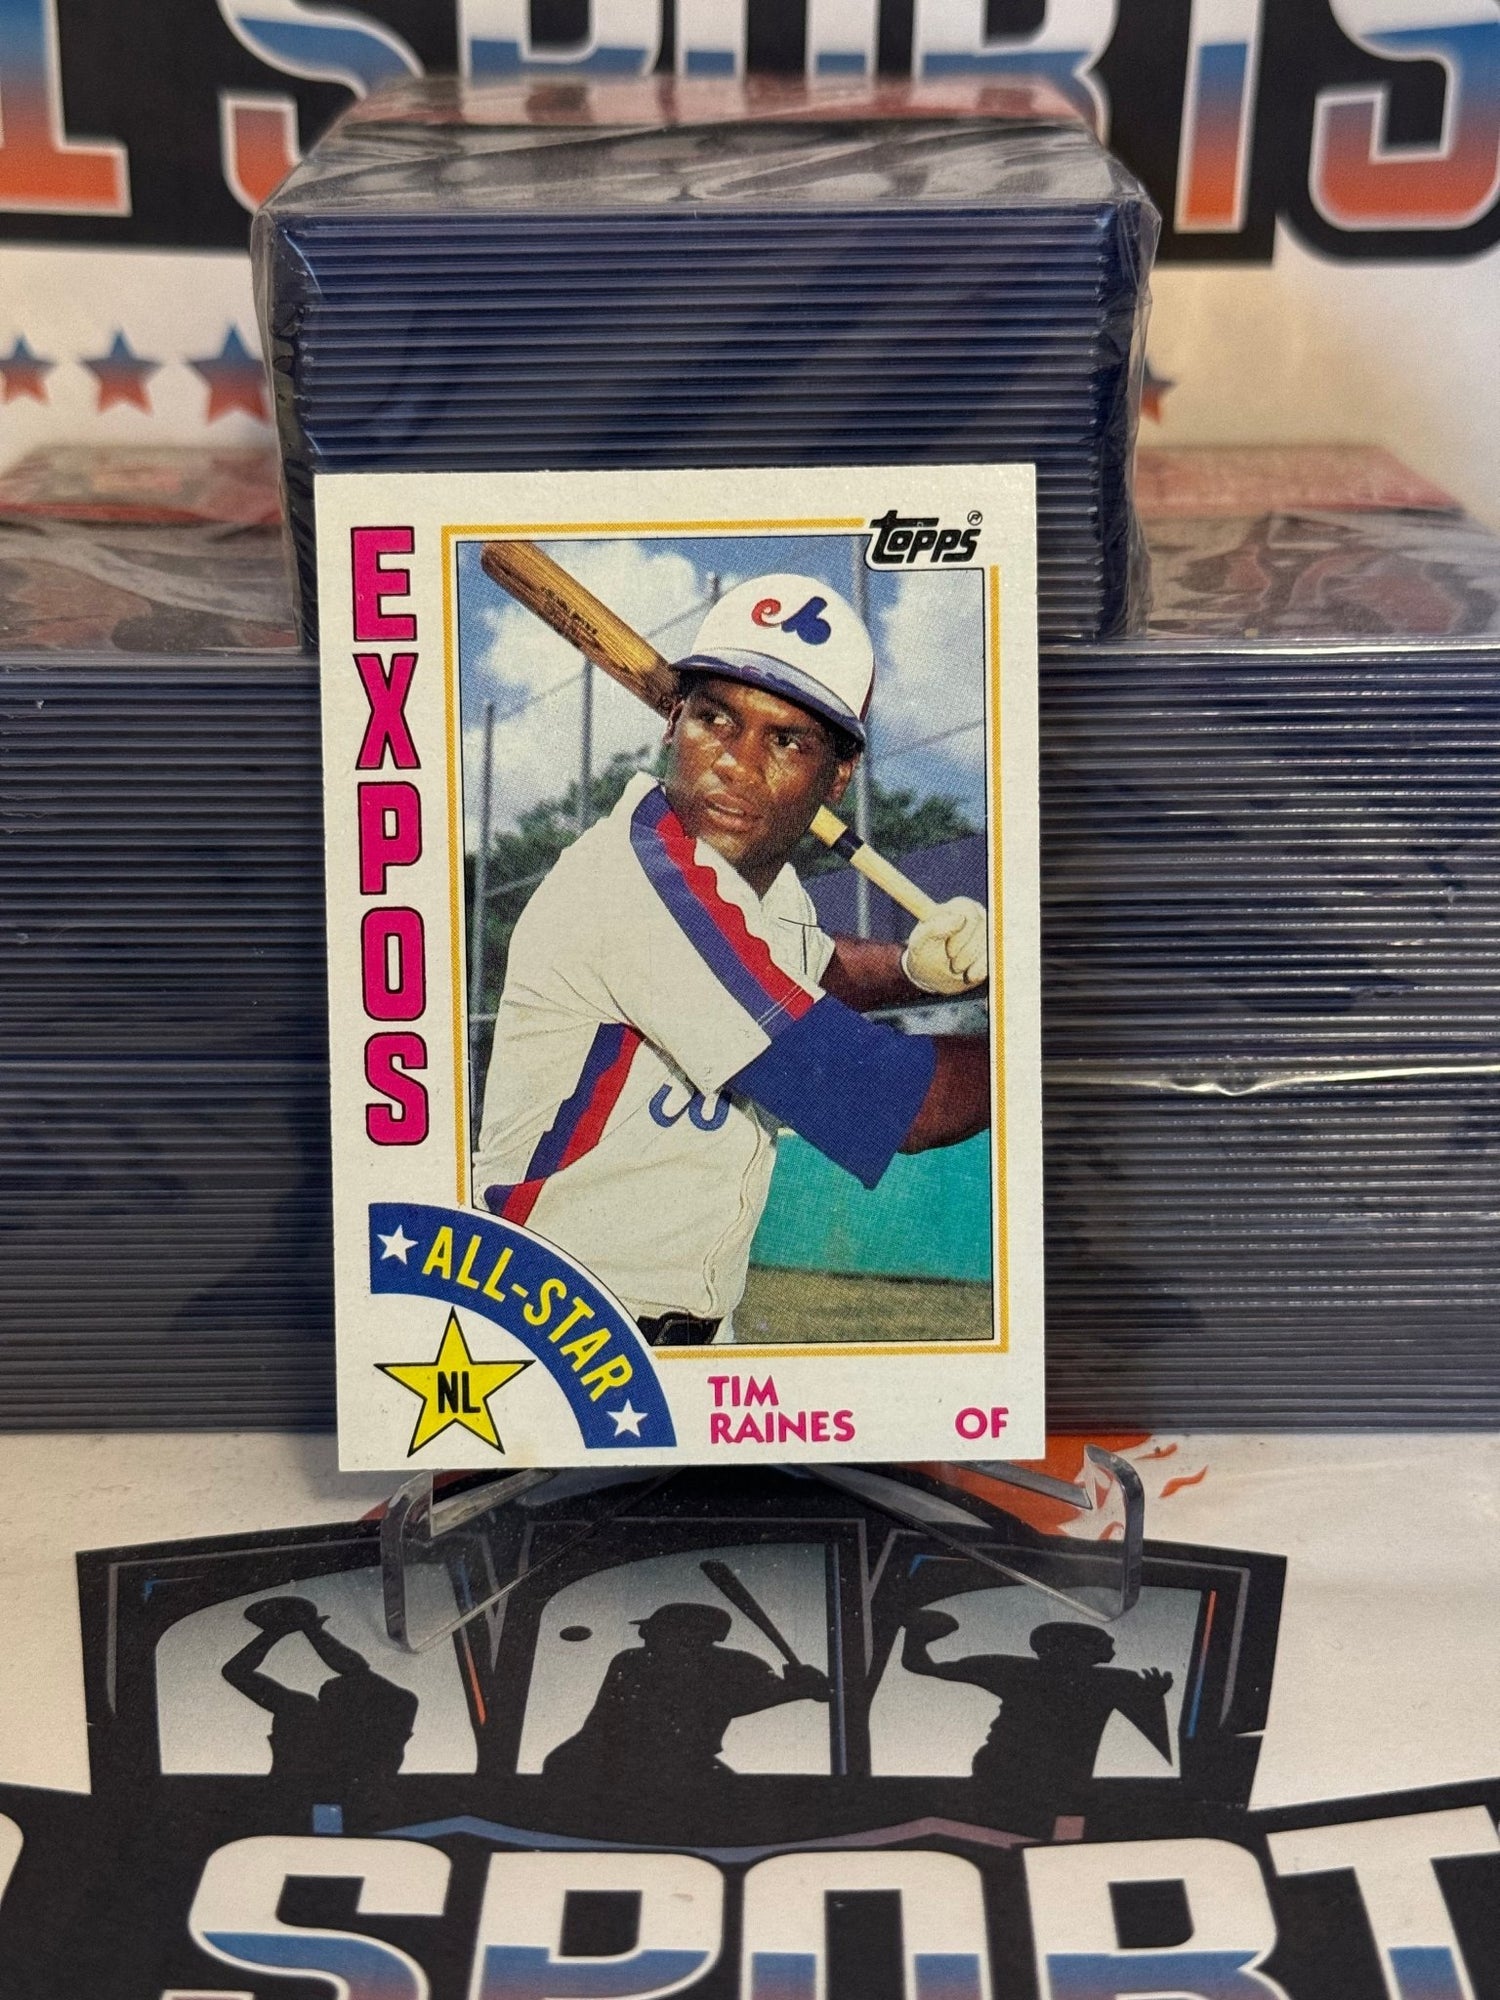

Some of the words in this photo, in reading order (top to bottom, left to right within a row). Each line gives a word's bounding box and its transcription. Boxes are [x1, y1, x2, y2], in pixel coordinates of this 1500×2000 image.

[351, 526, 429, 1146] EXPOS
[421, 1226, 634, 1402] ALL-STAR
[437, 1371, 481, 1413] NL
[707, 1375, 779, 1407] TIM
[710, 1410, 856, 1444] RAINES
[954, 1407, 1009, 1440] OF
